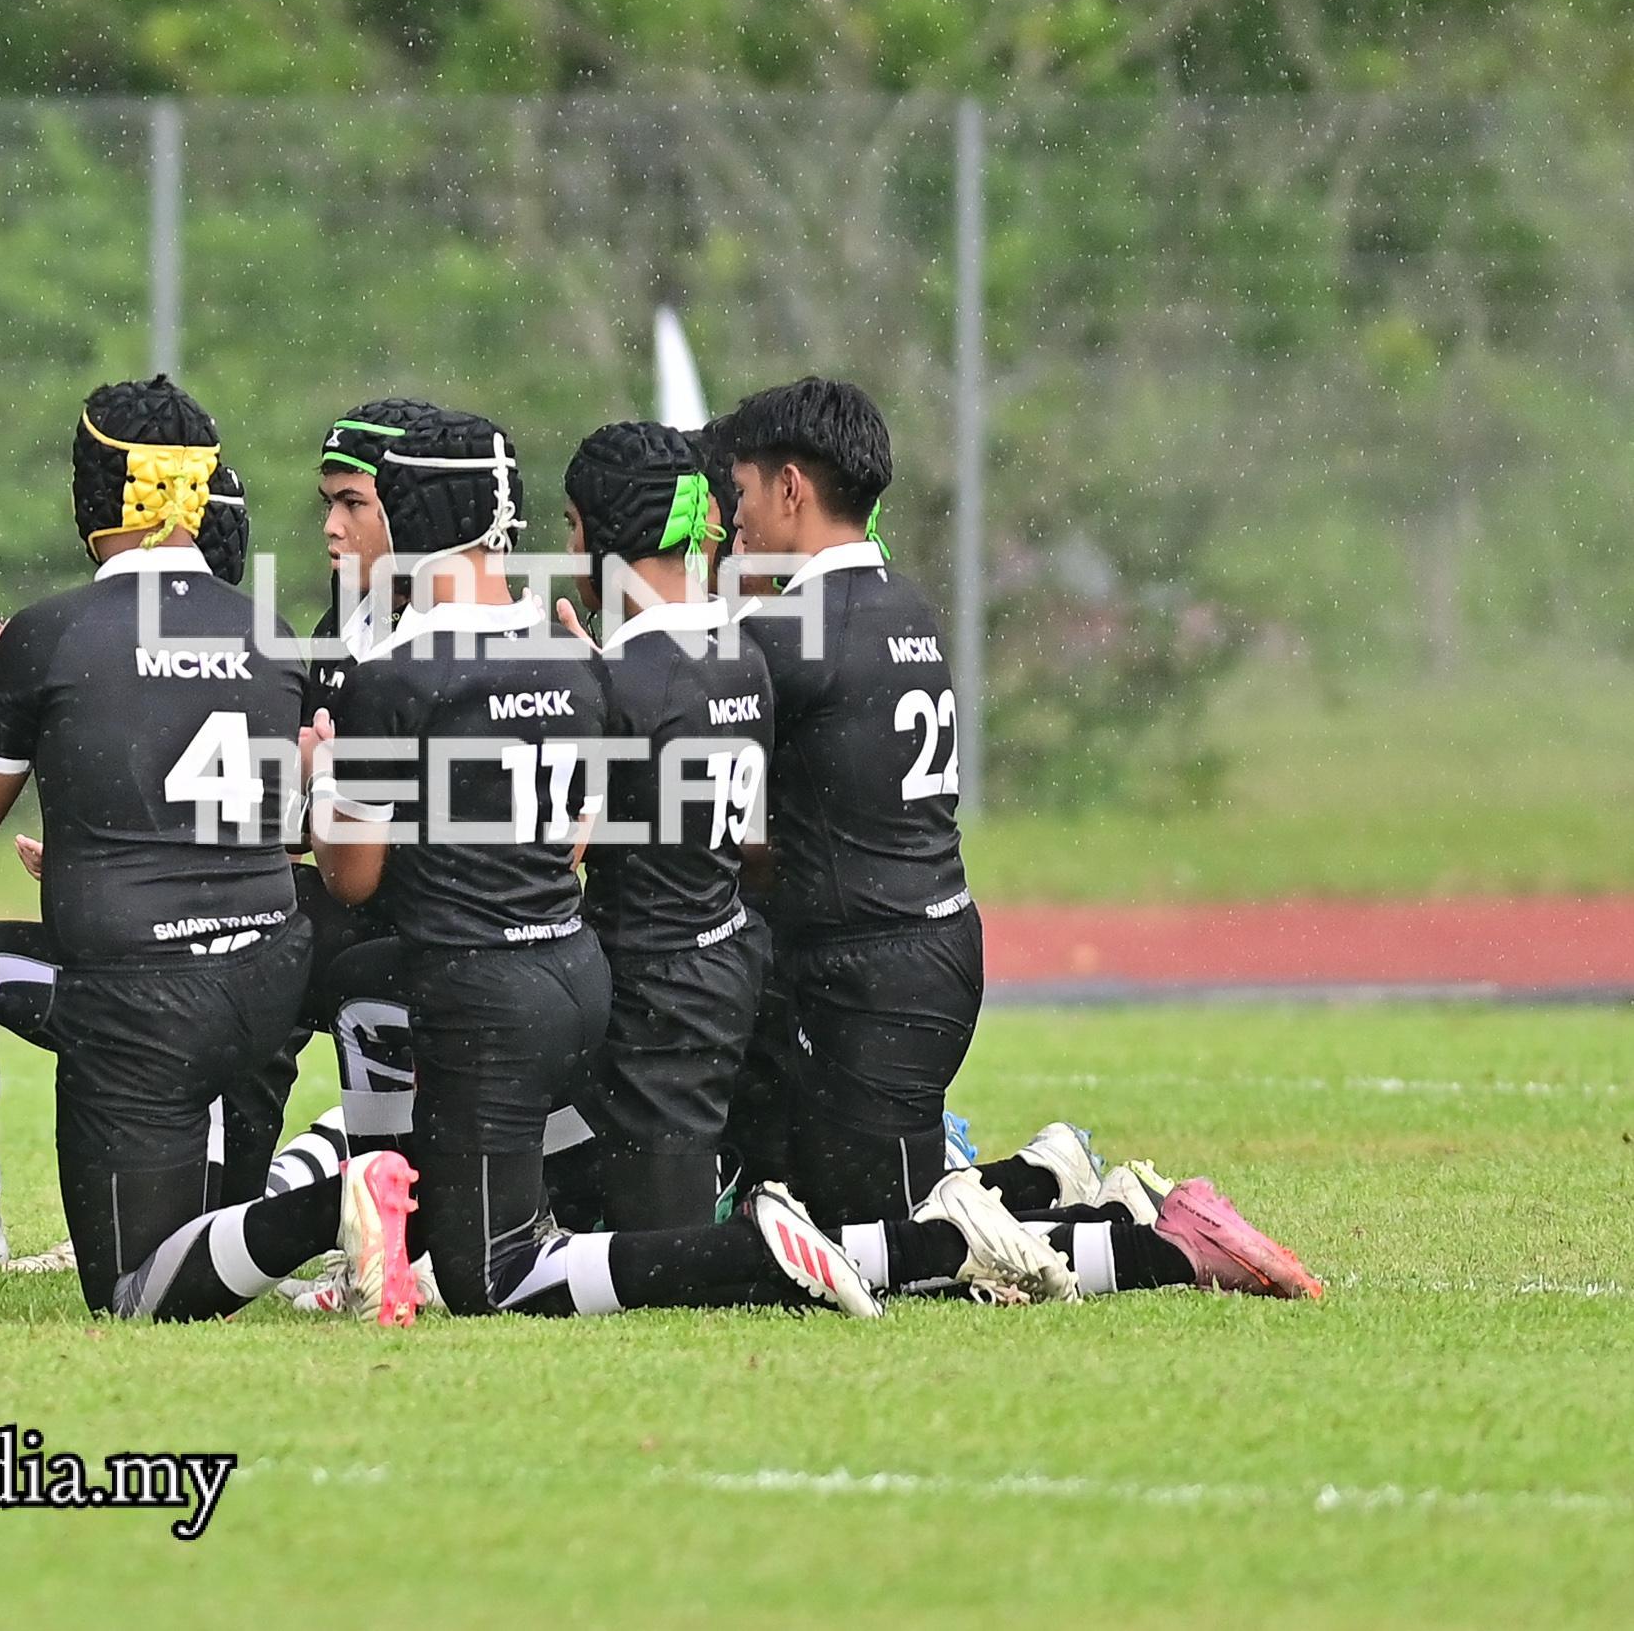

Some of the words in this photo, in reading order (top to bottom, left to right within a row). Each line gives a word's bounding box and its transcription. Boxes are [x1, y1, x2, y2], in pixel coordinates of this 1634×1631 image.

[136, 648, 252, 679] MCKK
[887, 635, 943, 664] MCKK
[488, 689, 575, 720] MCKK
[708, 693, 761, 726] MCKK
[164, 712, 264, 823] 4
[707, 745, 764, 850] 19
[153, 918, 221, 940] SMART
[503, 924, 552, 942] SMART
[696, 920, 733, 948] SMART
